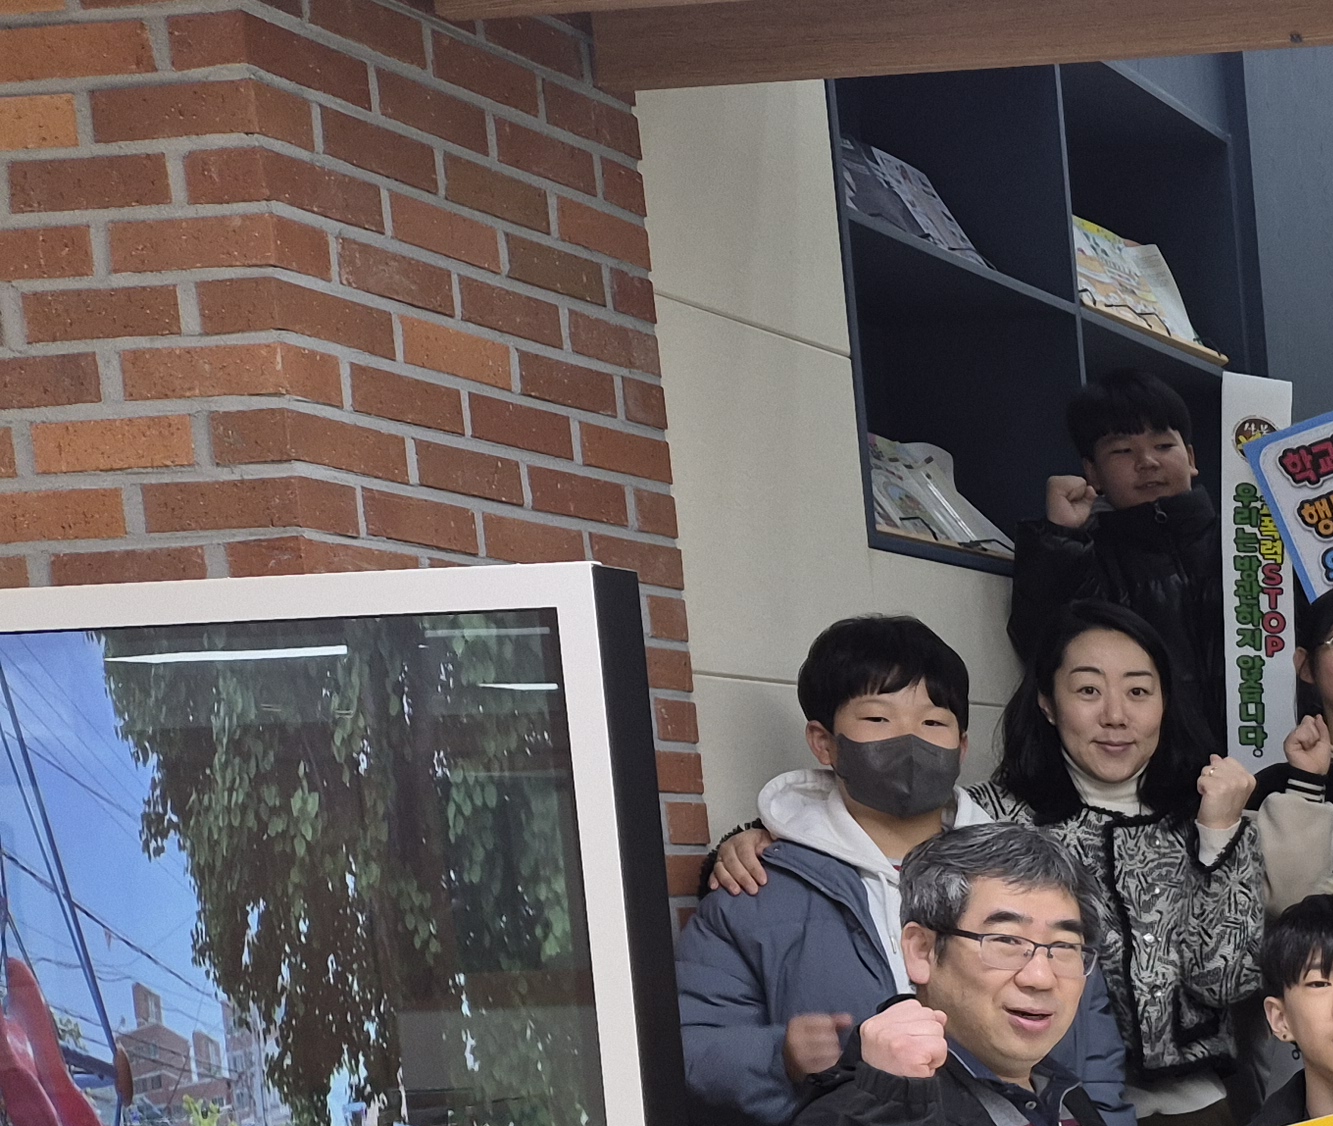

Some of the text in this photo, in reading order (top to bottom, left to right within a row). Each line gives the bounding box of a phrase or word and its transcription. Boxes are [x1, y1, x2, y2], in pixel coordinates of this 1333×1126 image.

[1232, 482, 1268, 758] 우리는 방관하지 않습니다.
